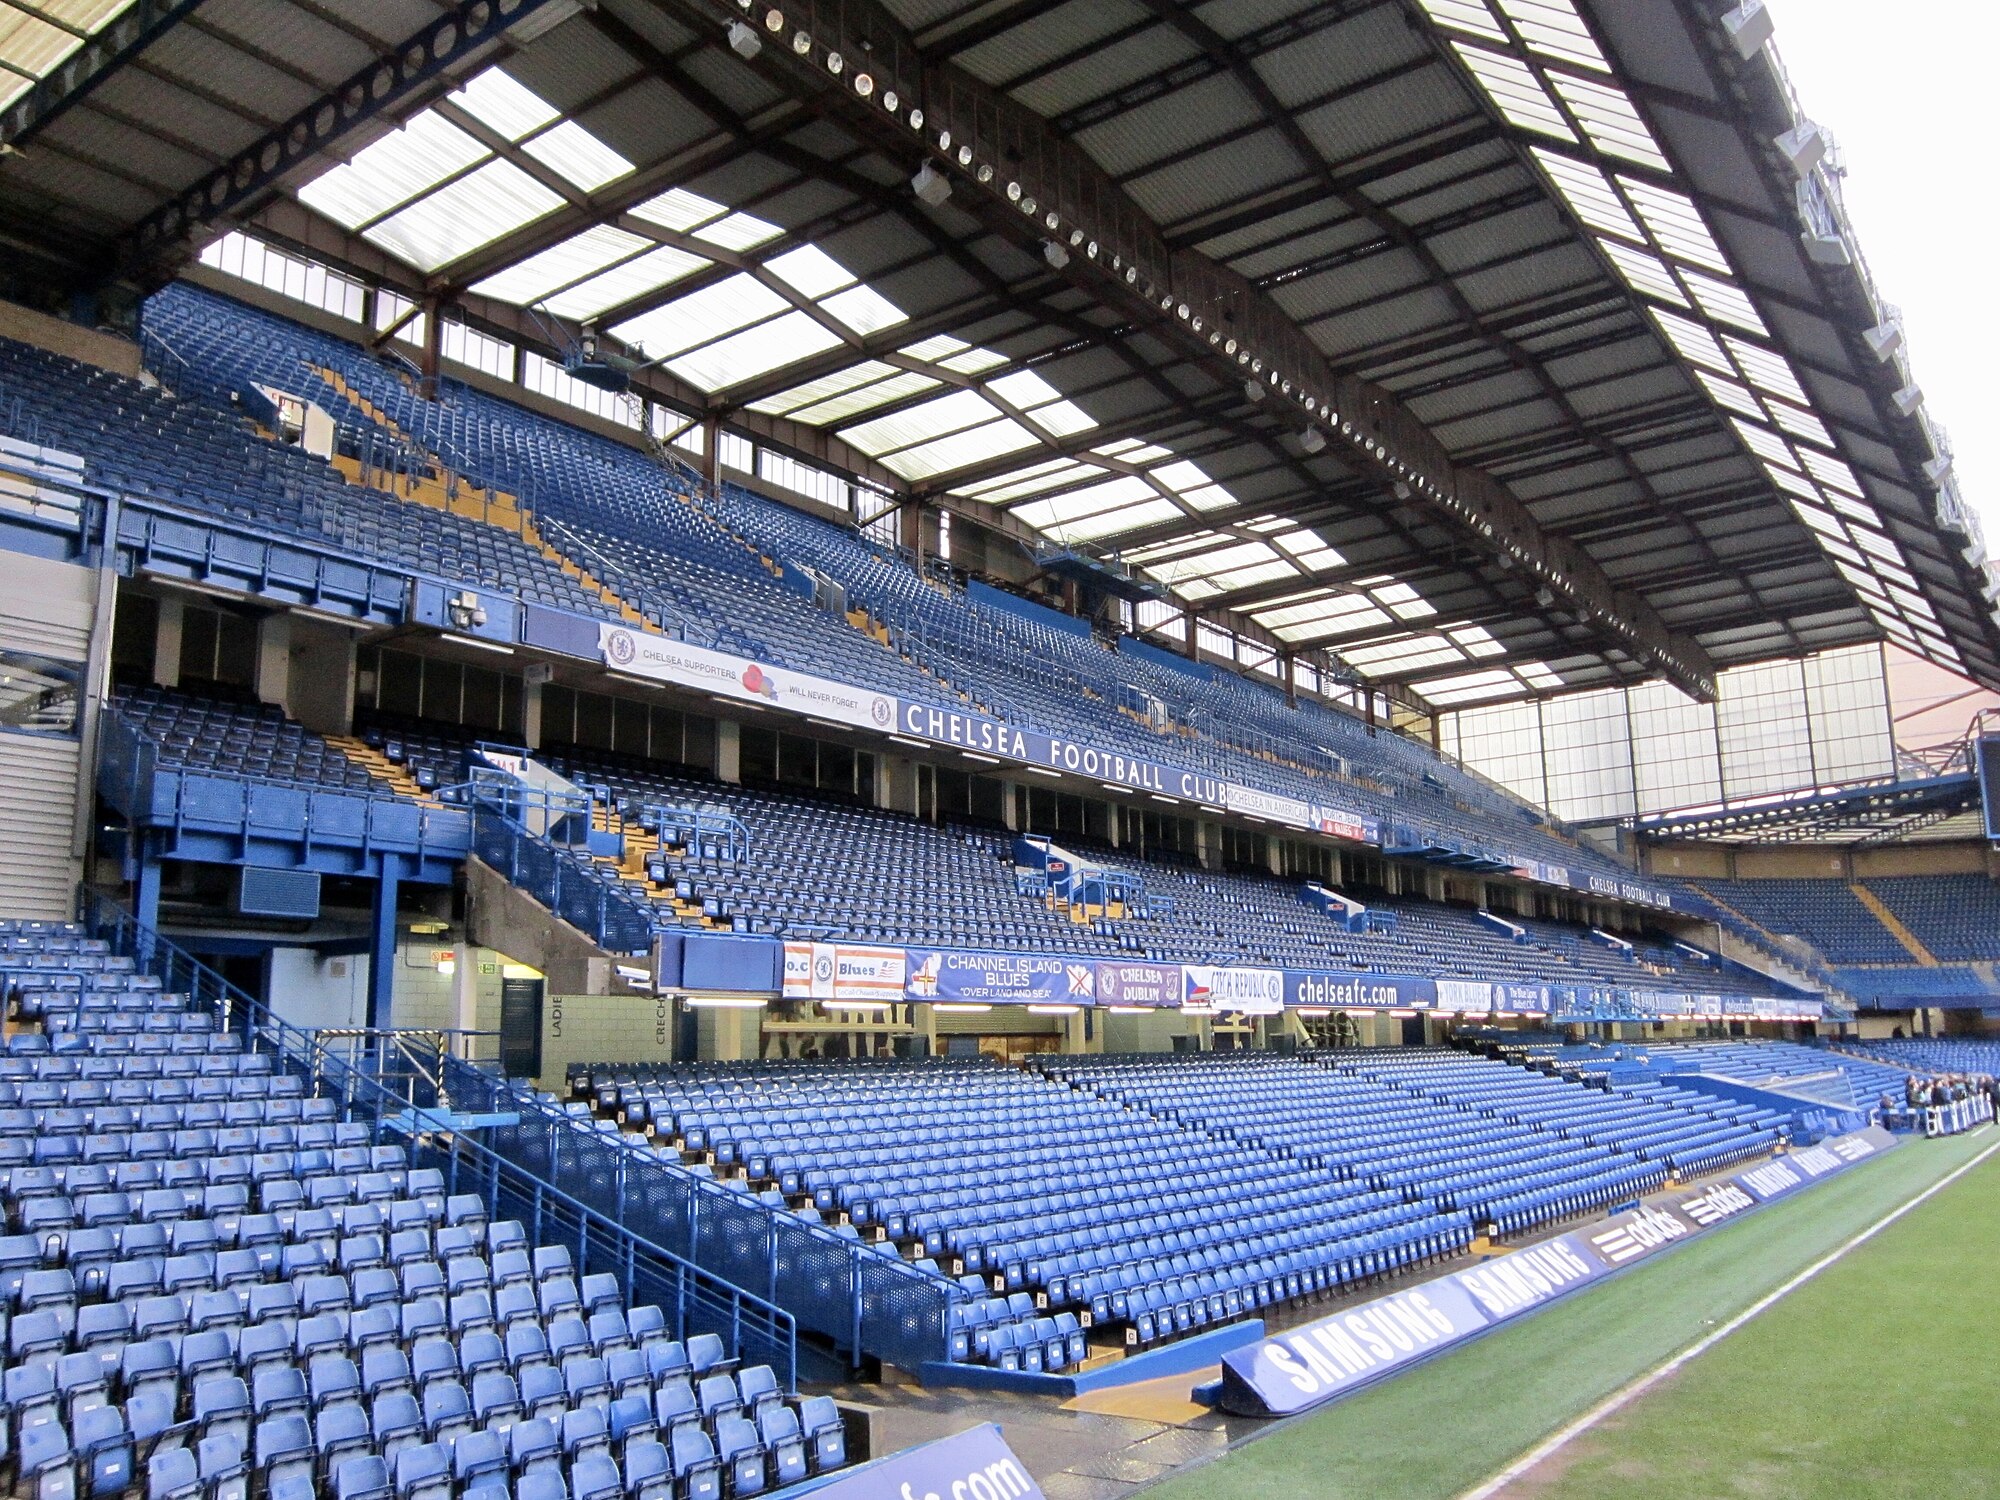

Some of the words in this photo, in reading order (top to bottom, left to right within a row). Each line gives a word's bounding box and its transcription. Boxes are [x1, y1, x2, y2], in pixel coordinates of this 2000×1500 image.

[643, 649, 683, 667] CHELSEA
[684, 658, 737, 680] SUPPORTERS
[789, 684, 806, 697] WILL
[807, 689, 831, 703] NEVER
[831, 695, 859, 709] FORGET
[907, 704, 1027, 758] CHELSEA
[1051, 740, 1163, 790] FOOTBALL
[1181, 773, 1227, 804] CLUB
[1233, 791, 1264, 809] CHELSEA
[1264, 799, 1273, 811] IN
[1274, 801, 1304, 818] AMERICA
[1323, 808, 1343, 821] NORTH
[1589, 876, 1619, 895] CHELSEA
[1622, 884, 1653, 903] FOOTBALL
[1655, 893, 1671, 907] CLUB
[839, 963, 875, 976] Blues
[947, 955, 1014, 972] CHANNEL
[1016, 960, 1063, 974] ISLAND
[1120, 968, 1163, 984] CHELSEA
[985, 972, 1030, 987] BLUES
[1211, 971, 1232, 997] CZECH
[1235, 972, 1266, 998] REPUBLIC
[1298, 976, 1398, 1005] chelseafc.com
[990, 988, 1012, 998] LAND
[1013, 989, 1032, 998] AND
[1123, 986, 1160, 1001] DUBLIN
[552, 996, 563, 1038] LADIE
[1705, 1182, 1754, 1215] adidas
[1626, 1205, 1688, 1248] adidas
[956, 1262, 961, 1272] G
[1461, 1241, 1591, 1313] SAMSUNG
[1040, 1294, 1045, 1303] E
[1083, 1313, 1089, 1323] D
[1129, 1331, 1134, 1341] C
[1264, 1292, 1455, 1394] SAMSUNG
